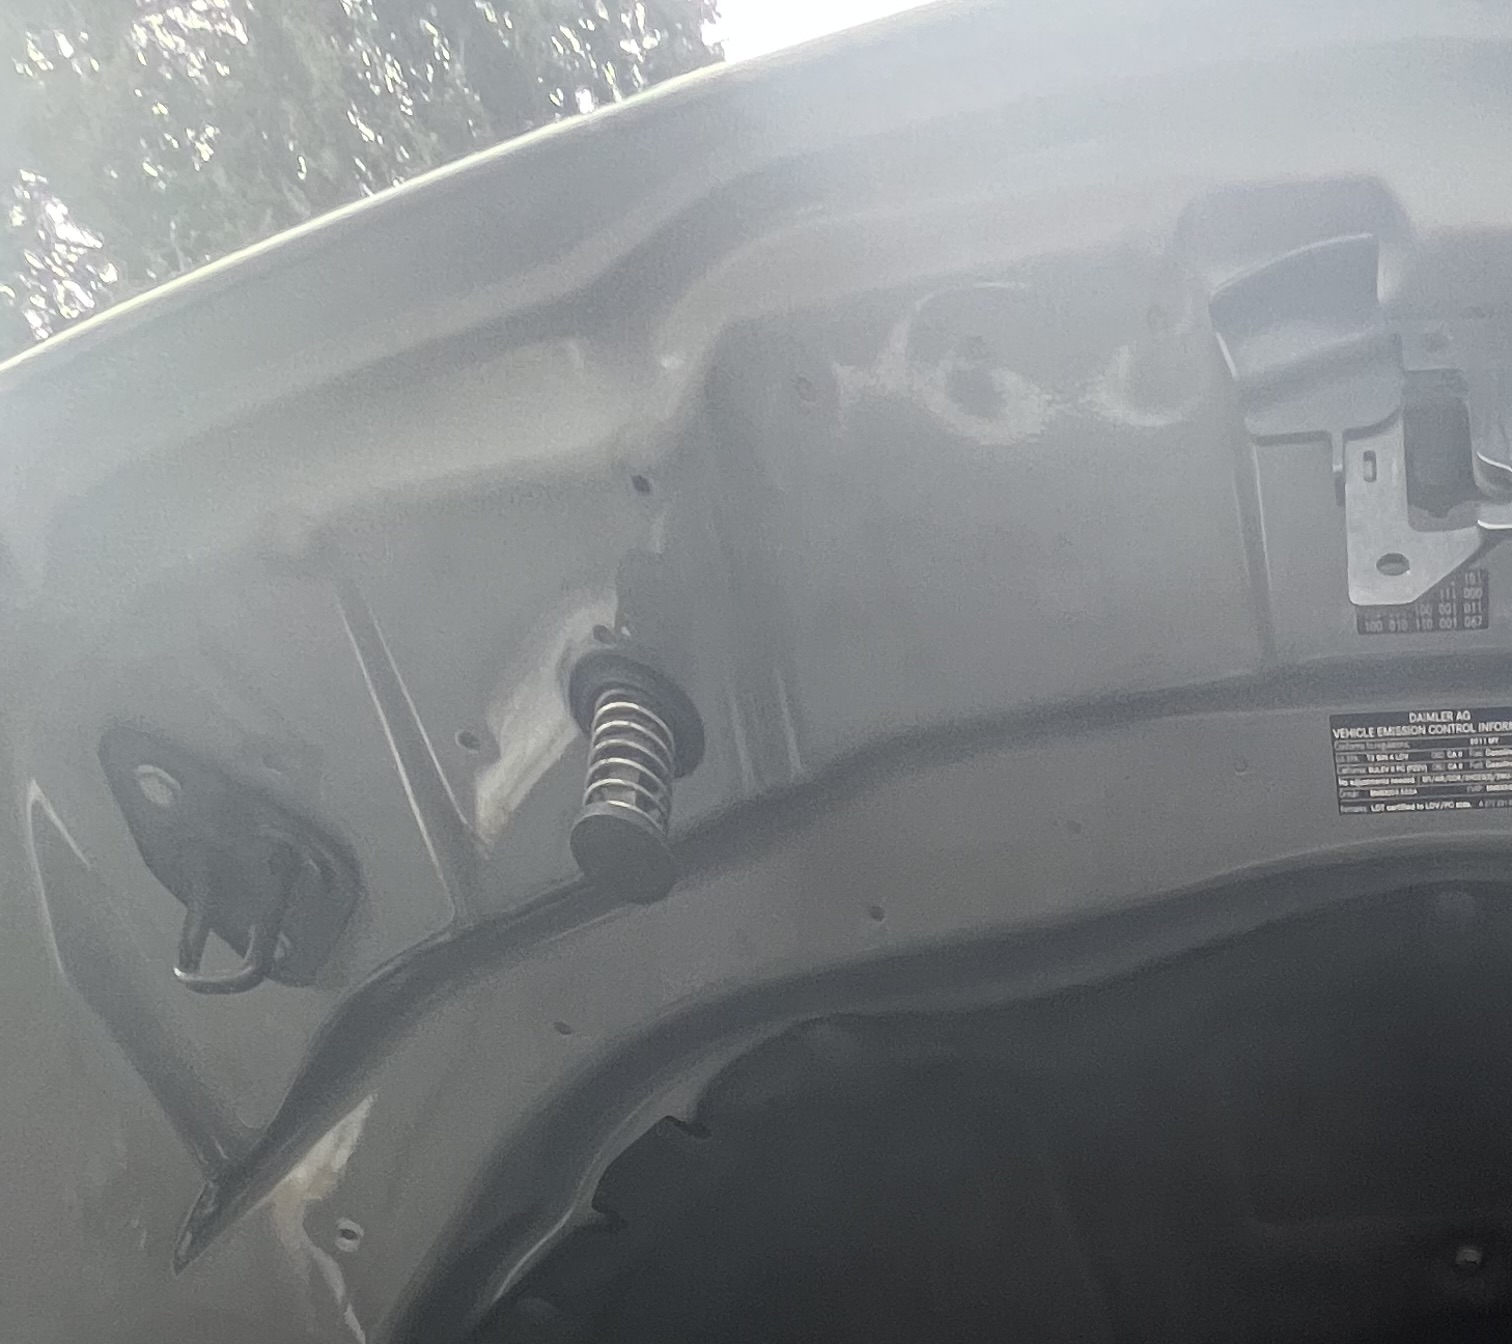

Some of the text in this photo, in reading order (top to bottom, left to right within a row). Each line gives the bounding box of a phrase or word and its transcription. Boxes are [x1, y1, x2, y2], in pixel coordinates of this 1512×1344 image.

[1409, 710, 1471, 723] DAIMLER AG
[1333, 727, 1375, 738] VEHICLE
[1377, 726, 1426, 737] EMISSION
[1428, 723, 1476, 735] CONTROL
